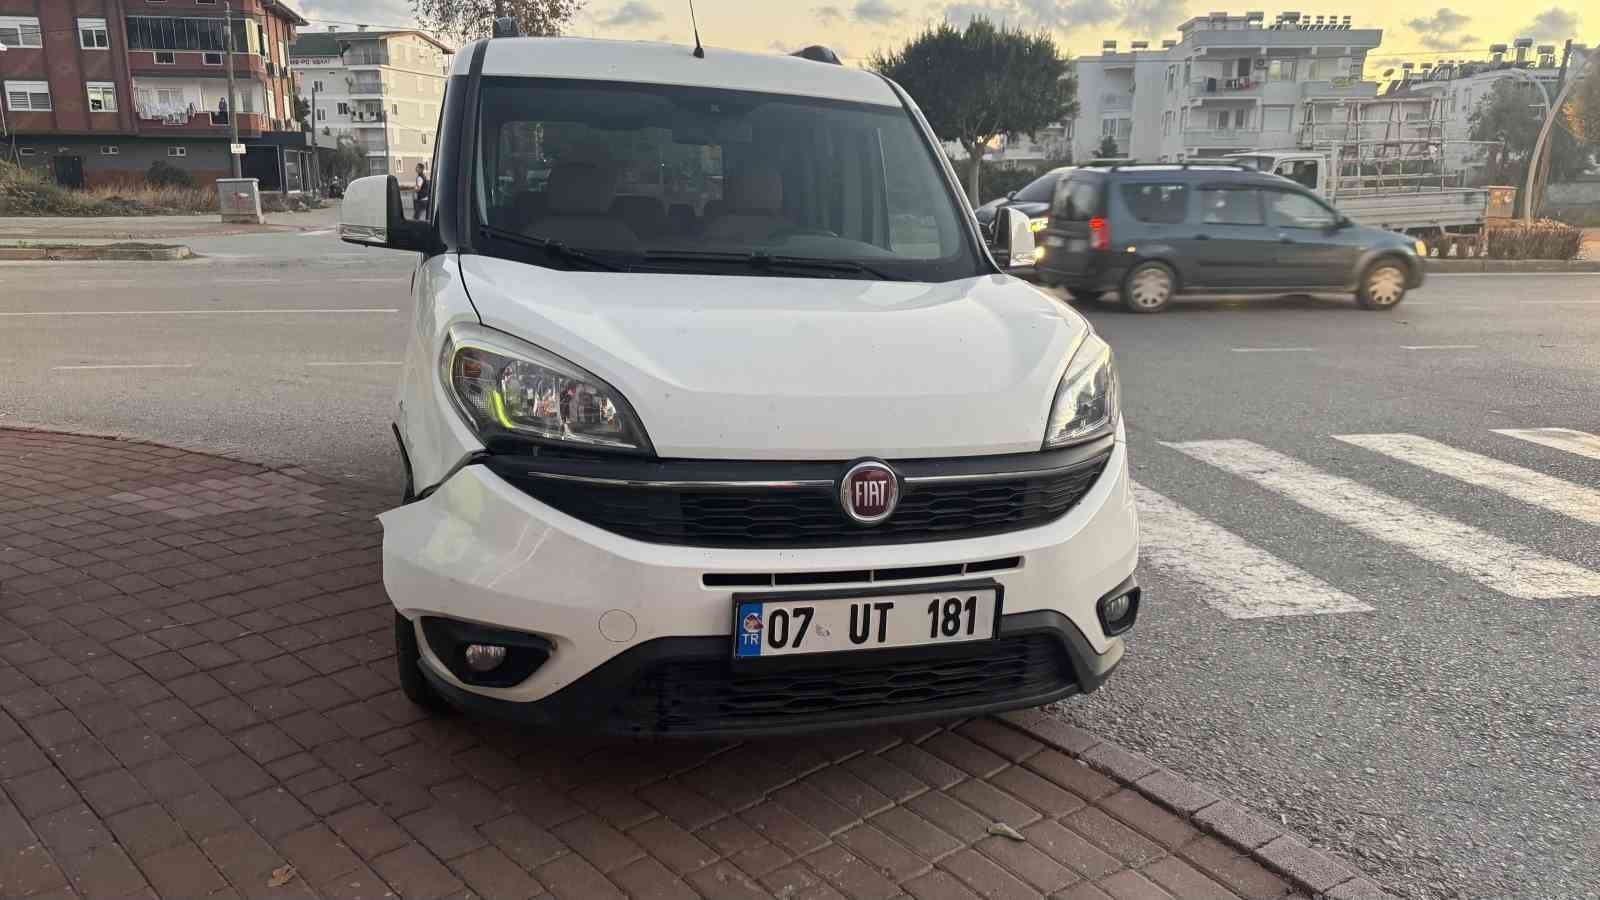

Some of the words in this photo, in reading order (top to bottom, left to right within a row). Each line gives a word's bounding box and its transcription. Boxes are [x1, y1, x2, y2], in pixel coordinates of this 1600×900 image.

[855, 480, 887, 507] FIAT
[768, 607, 815, 649] 07
[849, 602, 894, 645] UT
[928, 596, 977, 639] 181
[741, 633, 759, 645] TR
